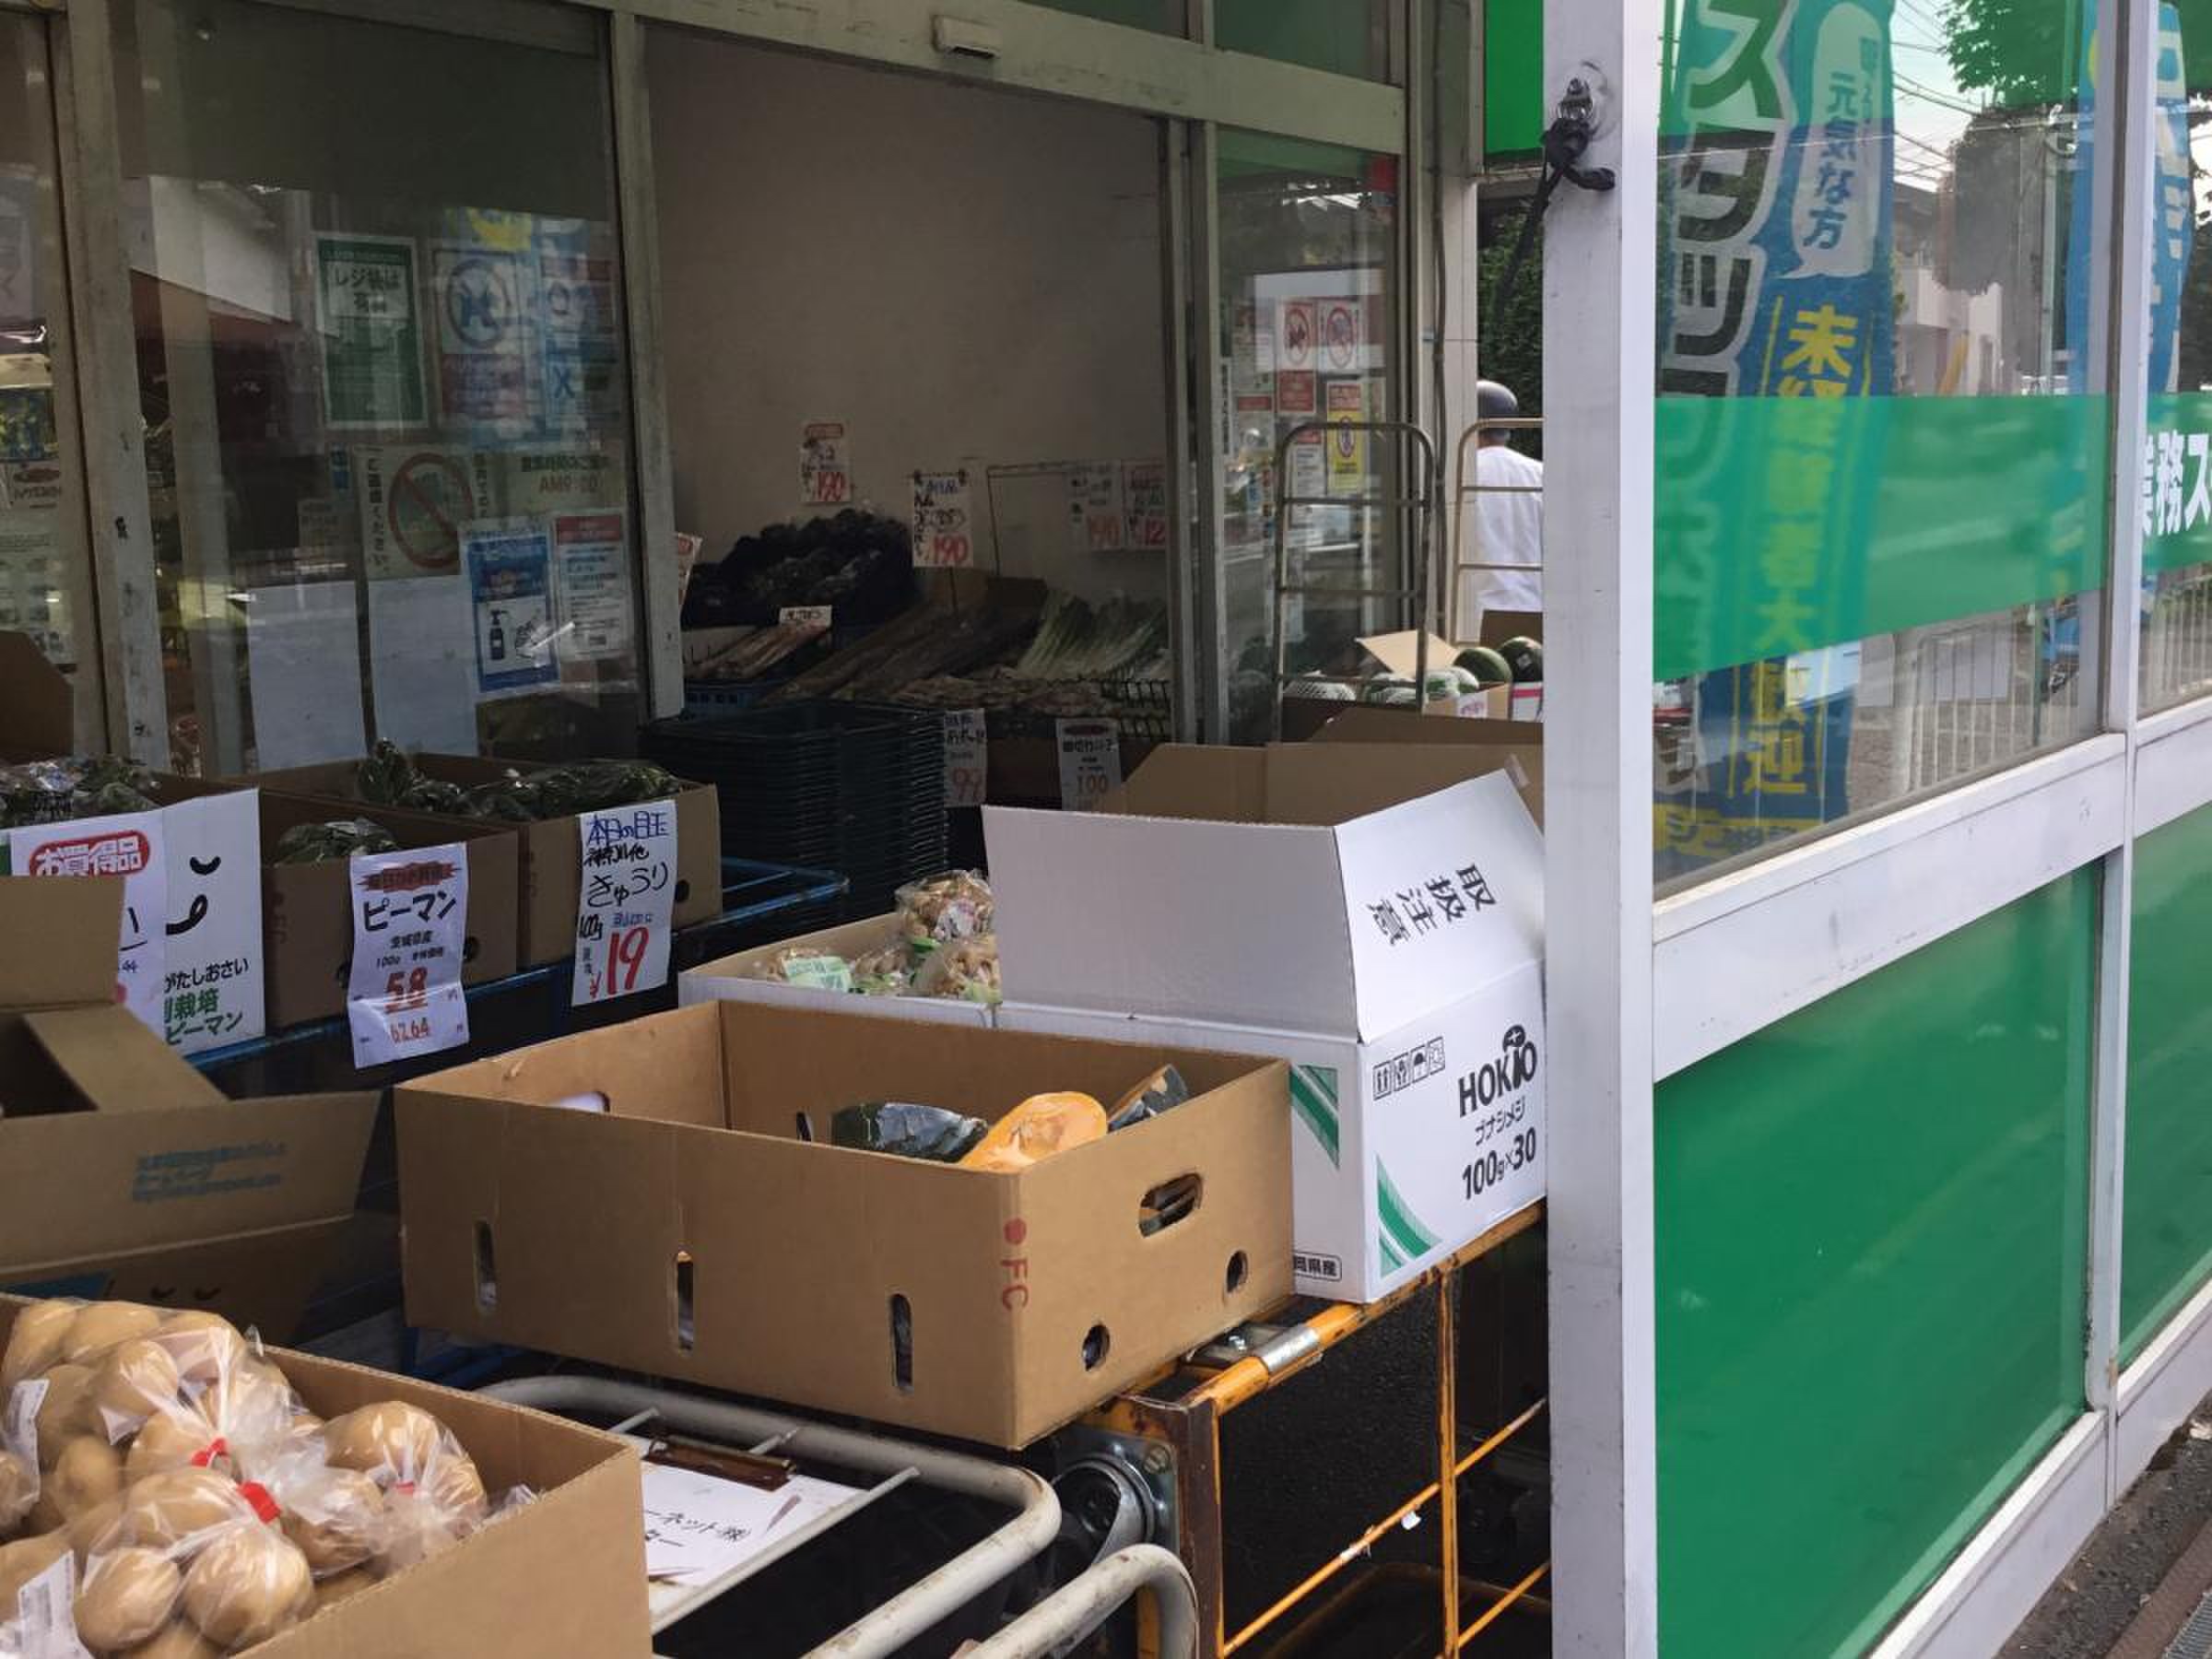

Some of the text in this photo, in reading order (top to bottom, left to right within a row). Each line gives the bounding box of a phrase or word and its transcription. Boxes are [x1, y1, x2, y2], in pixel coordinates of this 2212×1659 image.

[1803, 71, 1858, 250] 元気な方
[363, 890, 457, 932] ピーマン
[586, 862, 668, 908] きゅうり
[1368, 865, 1496, 946] 取扱注意
